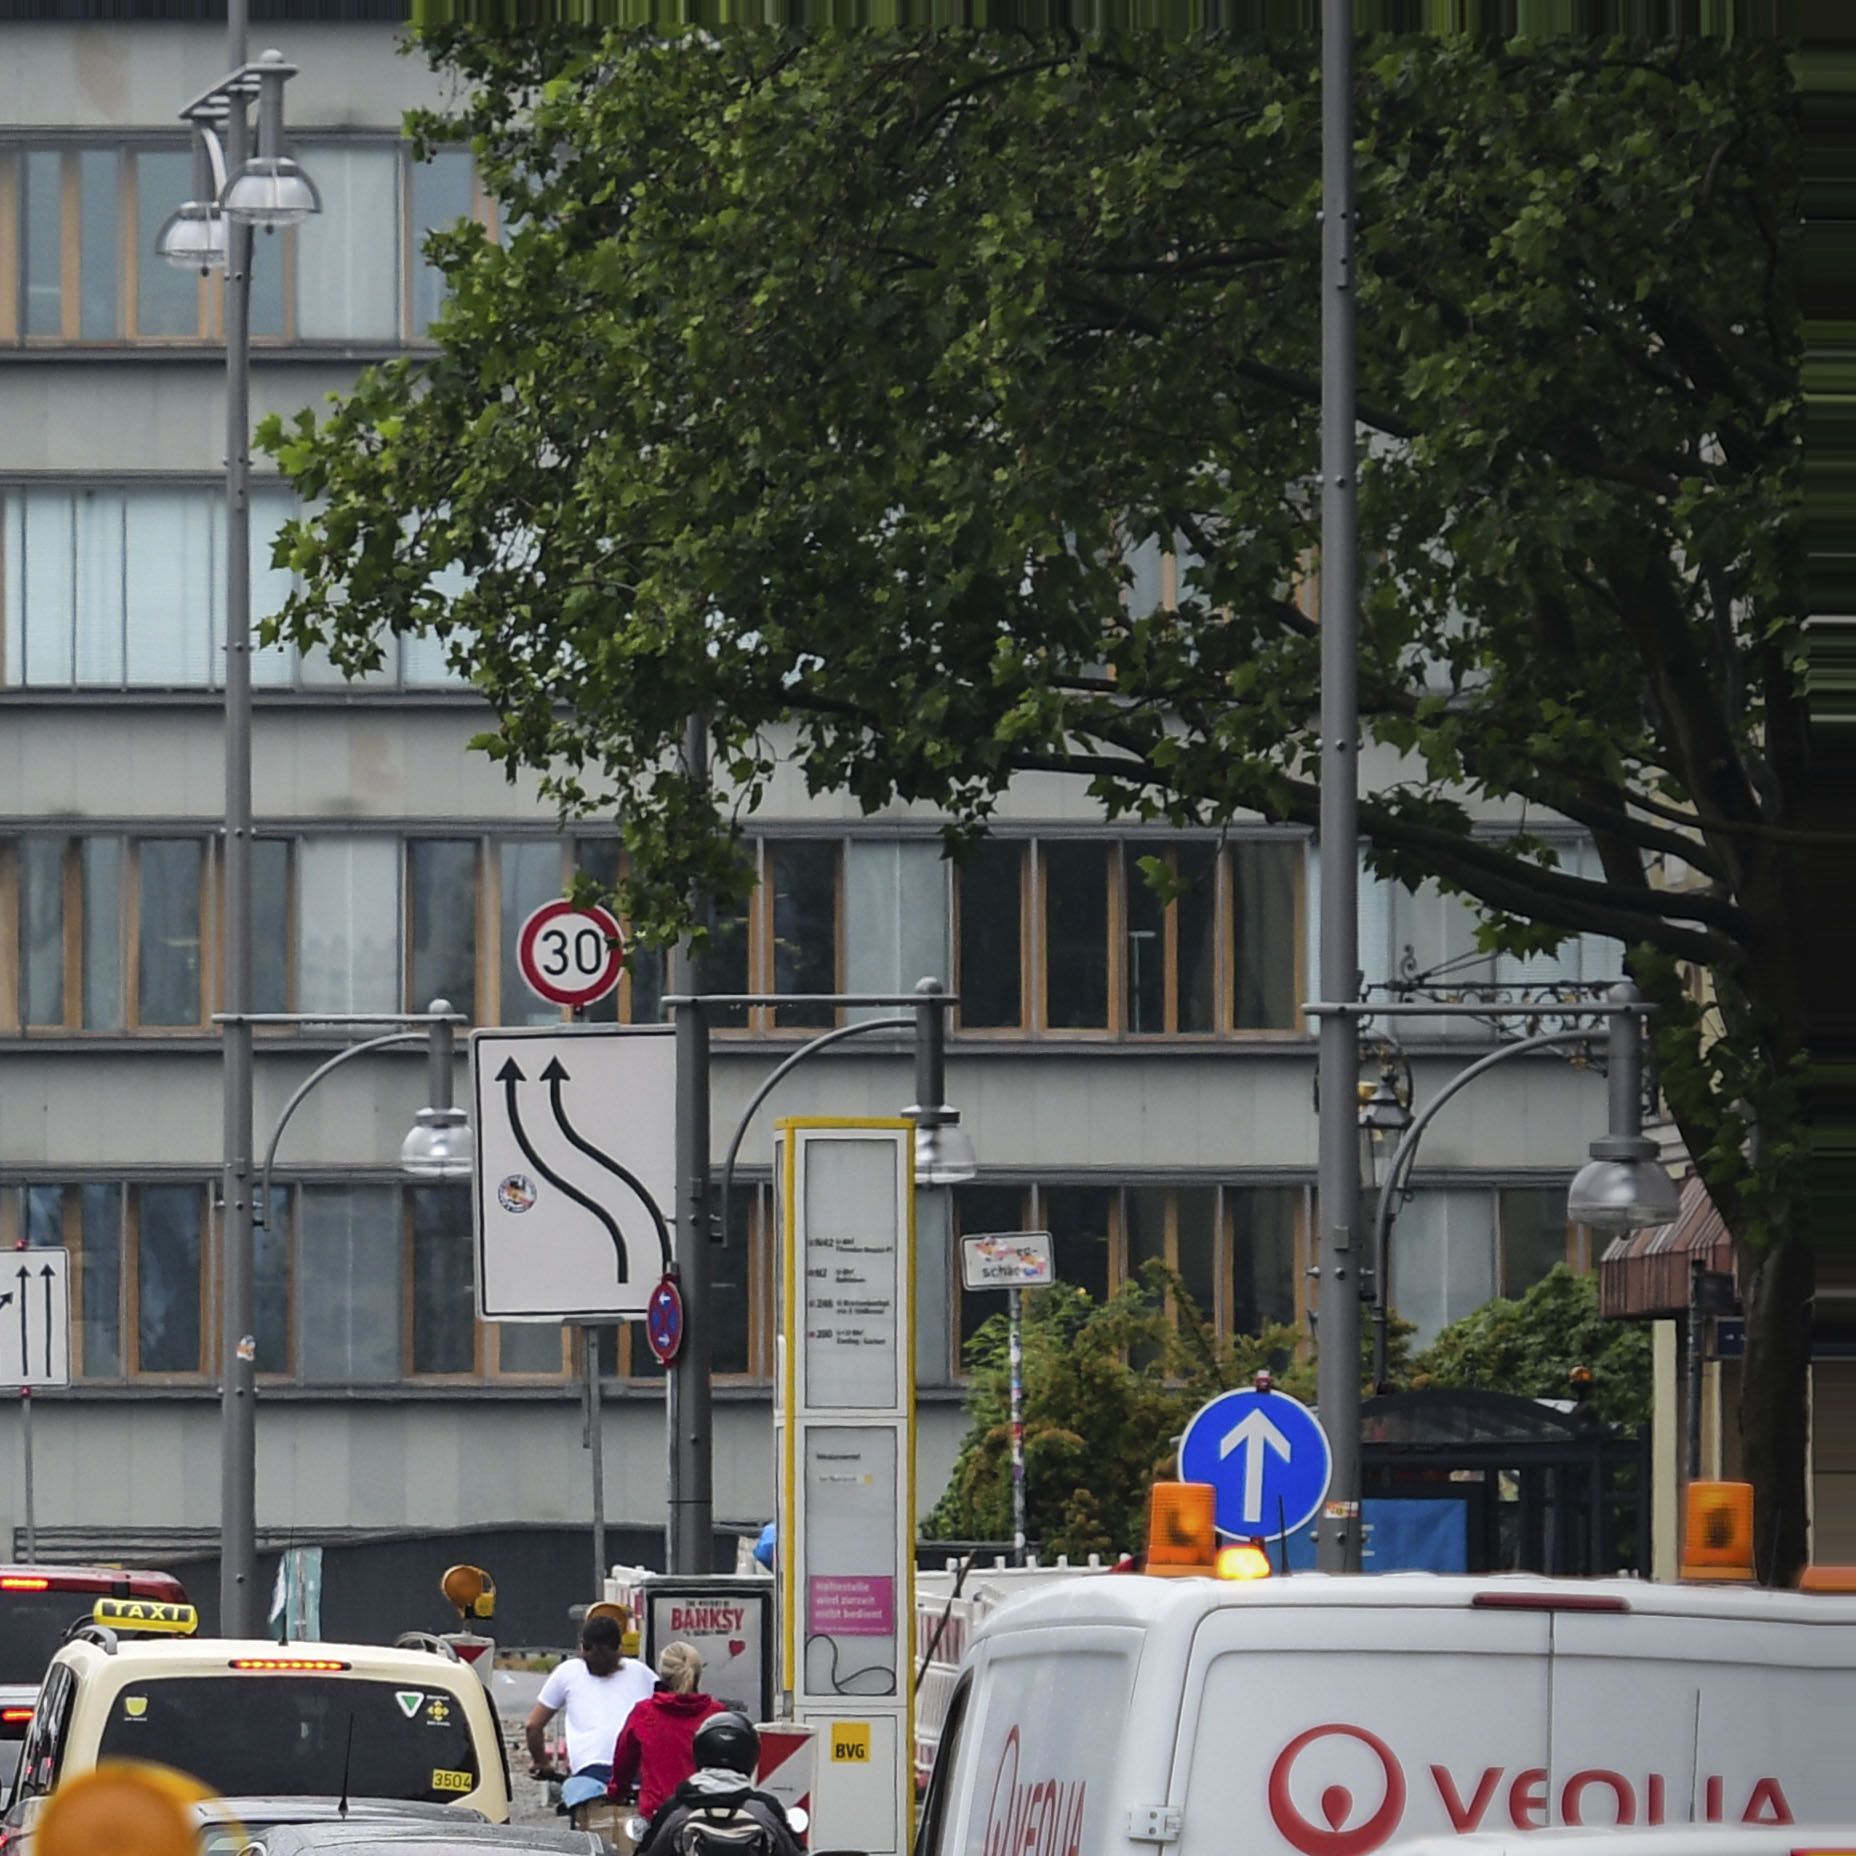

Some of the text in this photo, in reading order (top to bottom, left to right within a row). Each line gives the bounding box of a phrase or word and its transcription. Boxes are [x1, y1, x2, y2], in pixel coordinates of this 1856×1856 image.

[542, 928, 603, 976] 30
[114, 1600, 181, 1621] TAXI
[671, 1608, 744, 1630] BANKSY
[835, 1742, 865, 1760] BVG
[434, 1773, 471, 1788] 3504
